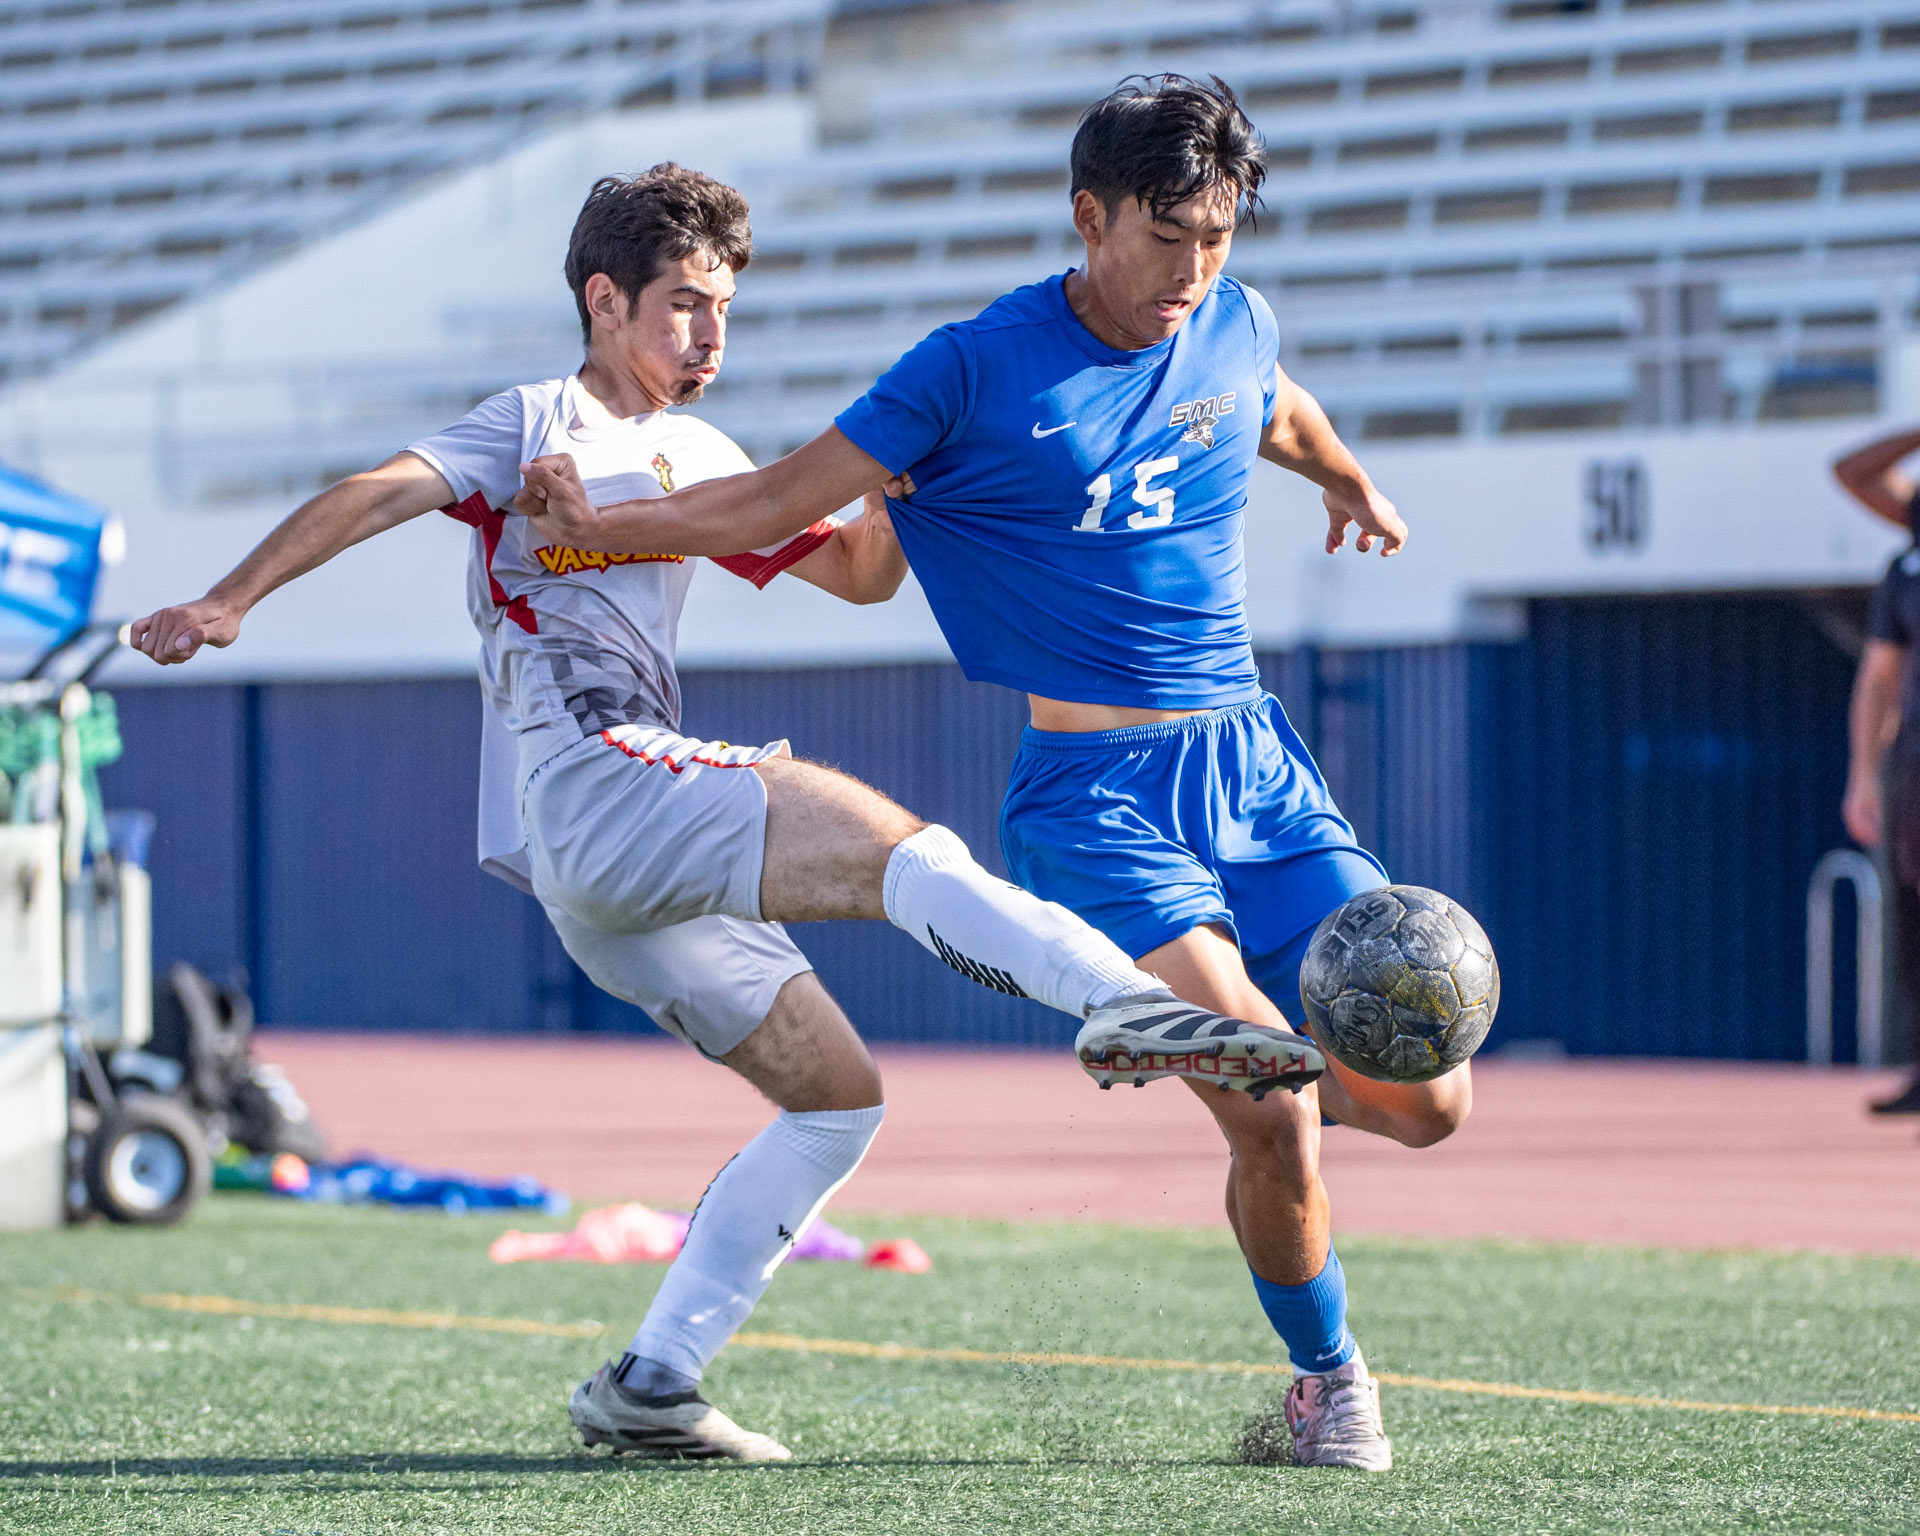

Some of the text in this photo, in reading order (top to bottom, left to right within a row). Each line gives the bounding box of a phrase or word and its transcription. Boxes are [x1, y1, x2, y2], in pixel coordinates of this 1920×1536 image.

[1168, 392, 1236, 427] SMC
[1072, 455, 1179, 532] 15
[1582, 459, 1649, 554] 50
